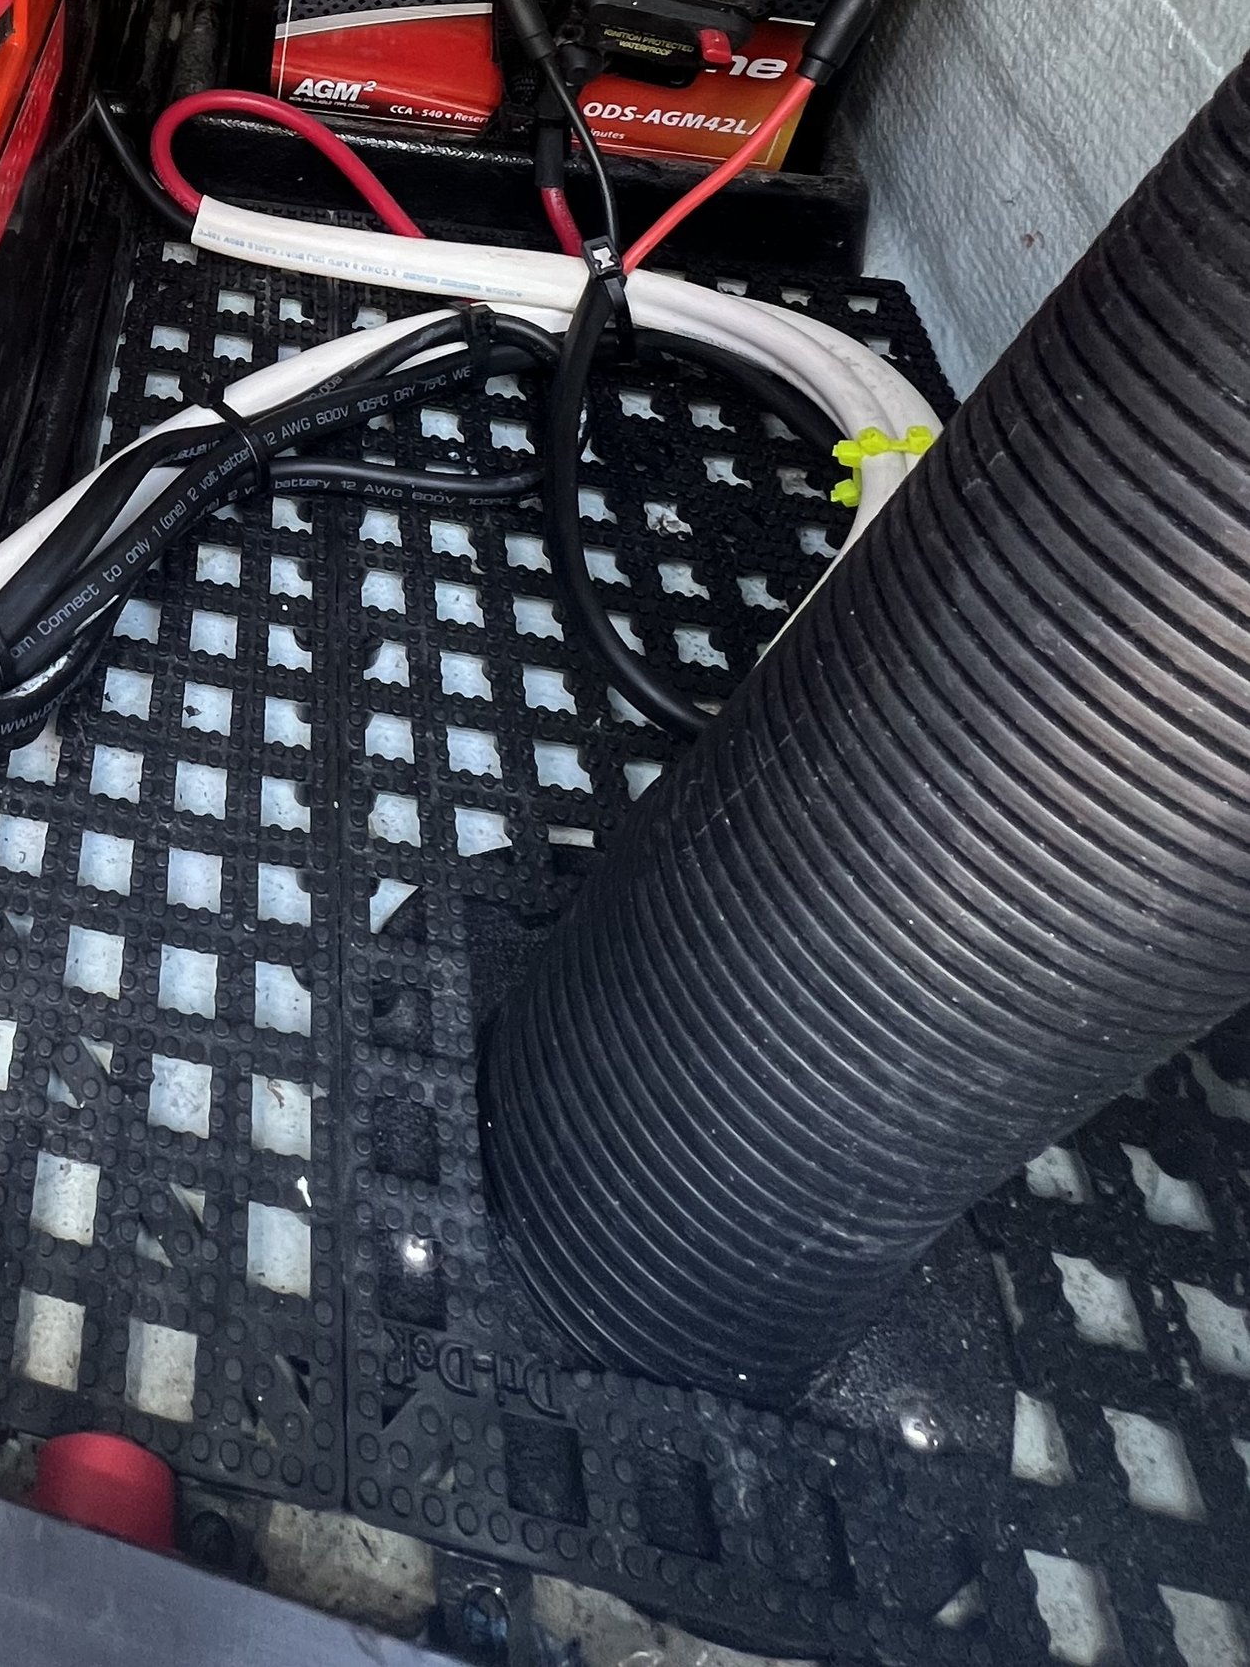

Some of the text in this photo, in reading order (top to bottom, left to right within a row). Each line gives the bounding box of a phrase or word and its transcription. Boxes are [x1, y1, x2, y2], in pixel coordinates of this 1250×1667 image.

[603, 29, 695, 54] IGNITION PROTECTED
[618, 40, 673, 57] WATERPROOF
[389, 104, 414, 116] CCA
[421, 108, 444, 119] 540
[589, 128, 626, 140] inutes
[262, 431, 277, 447] 12
[281, 417, 312, 440] AWG
[316, 405, 351, 426] 600V
[393, 385, 416, 403] DRY
[452, 366, 472, 379] WE
[274, 477, 332, 490] battery
[340, 480, 357, 491] 12
[363, 483, 404, 498] AWG
[411, 491, 457, 505] 600V
[36, 582, 100, 635] Connect
[102, 564, 123, 583] to
[125, 537, 153, 565] only
[159, 499, 188, 531] (one)
[200, 469, 220, 491] volt
[220, 446, 251, 476] batter
